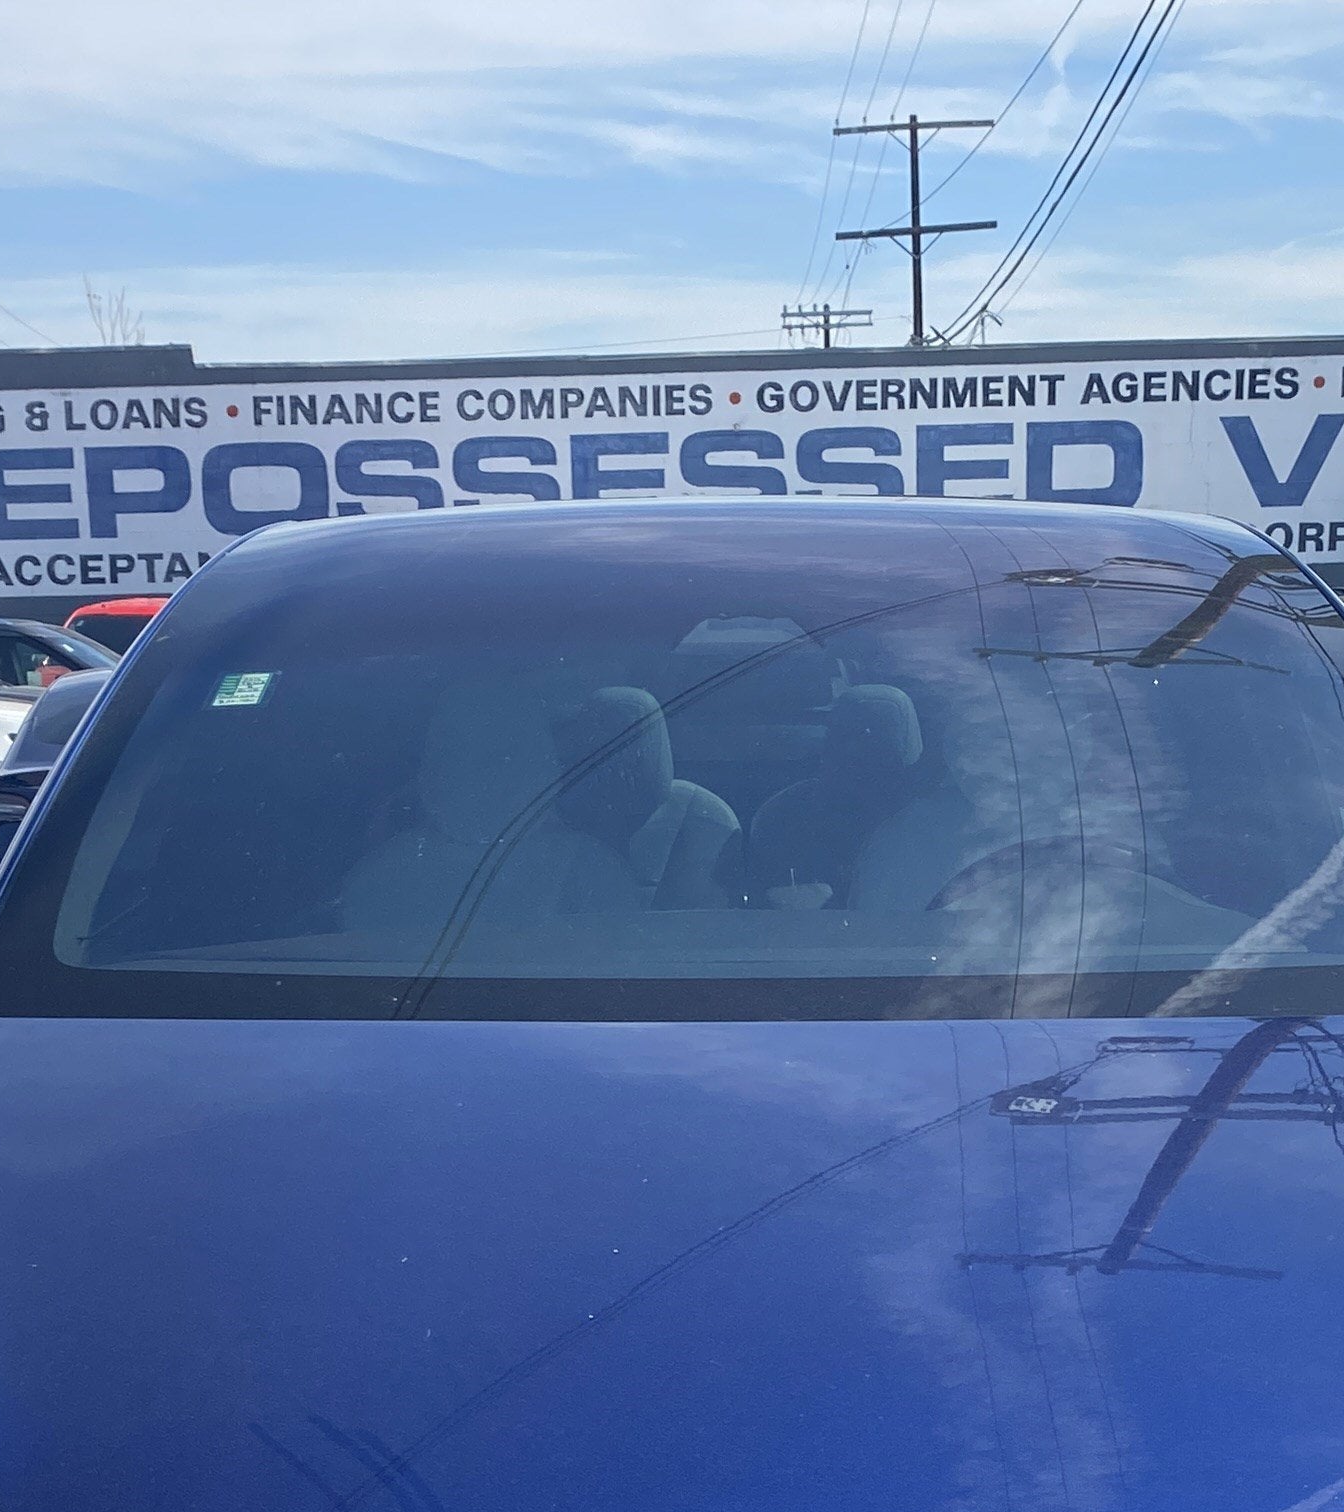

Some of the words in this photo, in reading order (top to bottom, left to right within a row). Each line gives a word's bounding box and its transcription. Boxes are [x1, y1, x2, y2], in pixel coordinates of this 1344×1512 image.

[25, 400, 50, 432] &
[64, 397, 208, 432] LOANS
[253, 391, 441, 427] FINANCE
[456, 383, 713, 422] COMPANIES
[756, 371, 1066, 414] GOVERNMENT
[1081, 367, 1300, 405] AGENCIES
